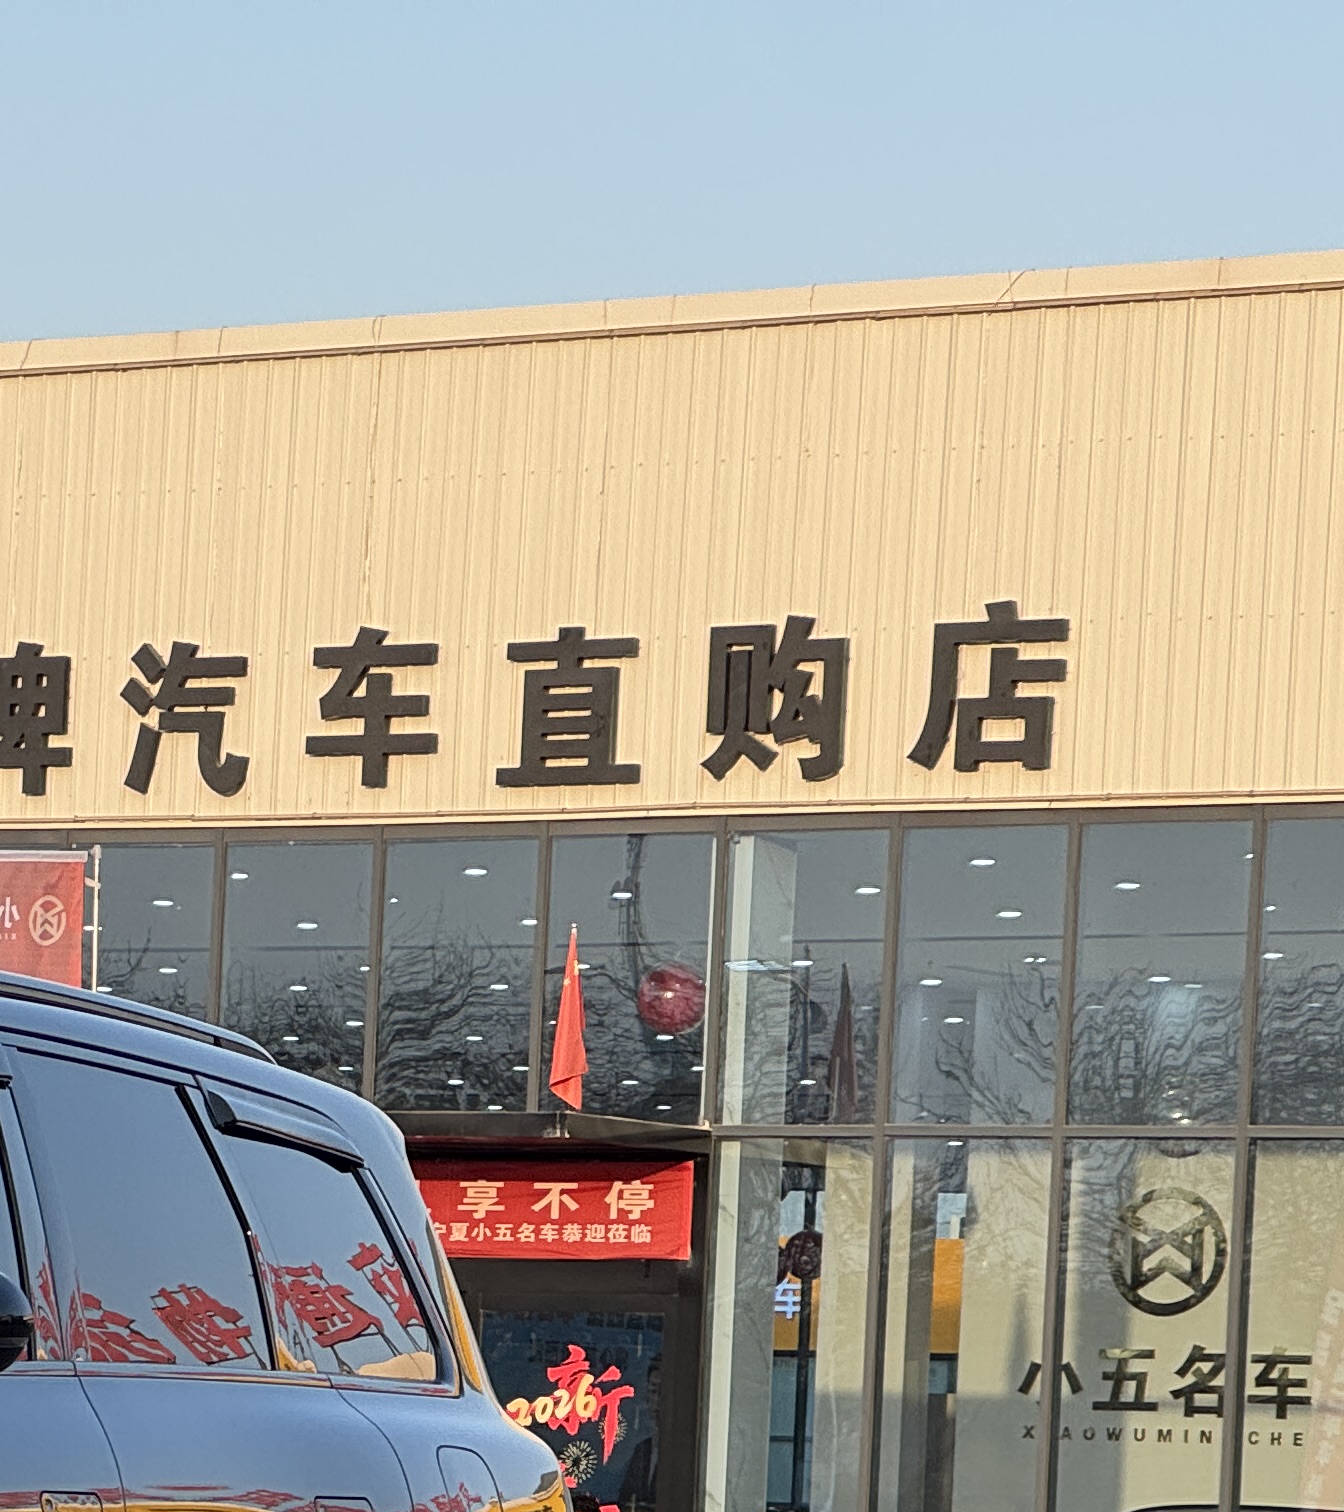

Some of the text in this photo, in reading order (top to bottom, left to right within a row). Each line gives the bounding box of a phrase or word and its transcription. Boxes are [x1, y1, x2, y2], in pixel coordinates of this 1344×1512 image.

[415, 1179, 655, 1220] 享不停
[506, 1374, 597, 1427] 2026
[1021, 1424, 1304, 1447] XAOWUMINCHE
